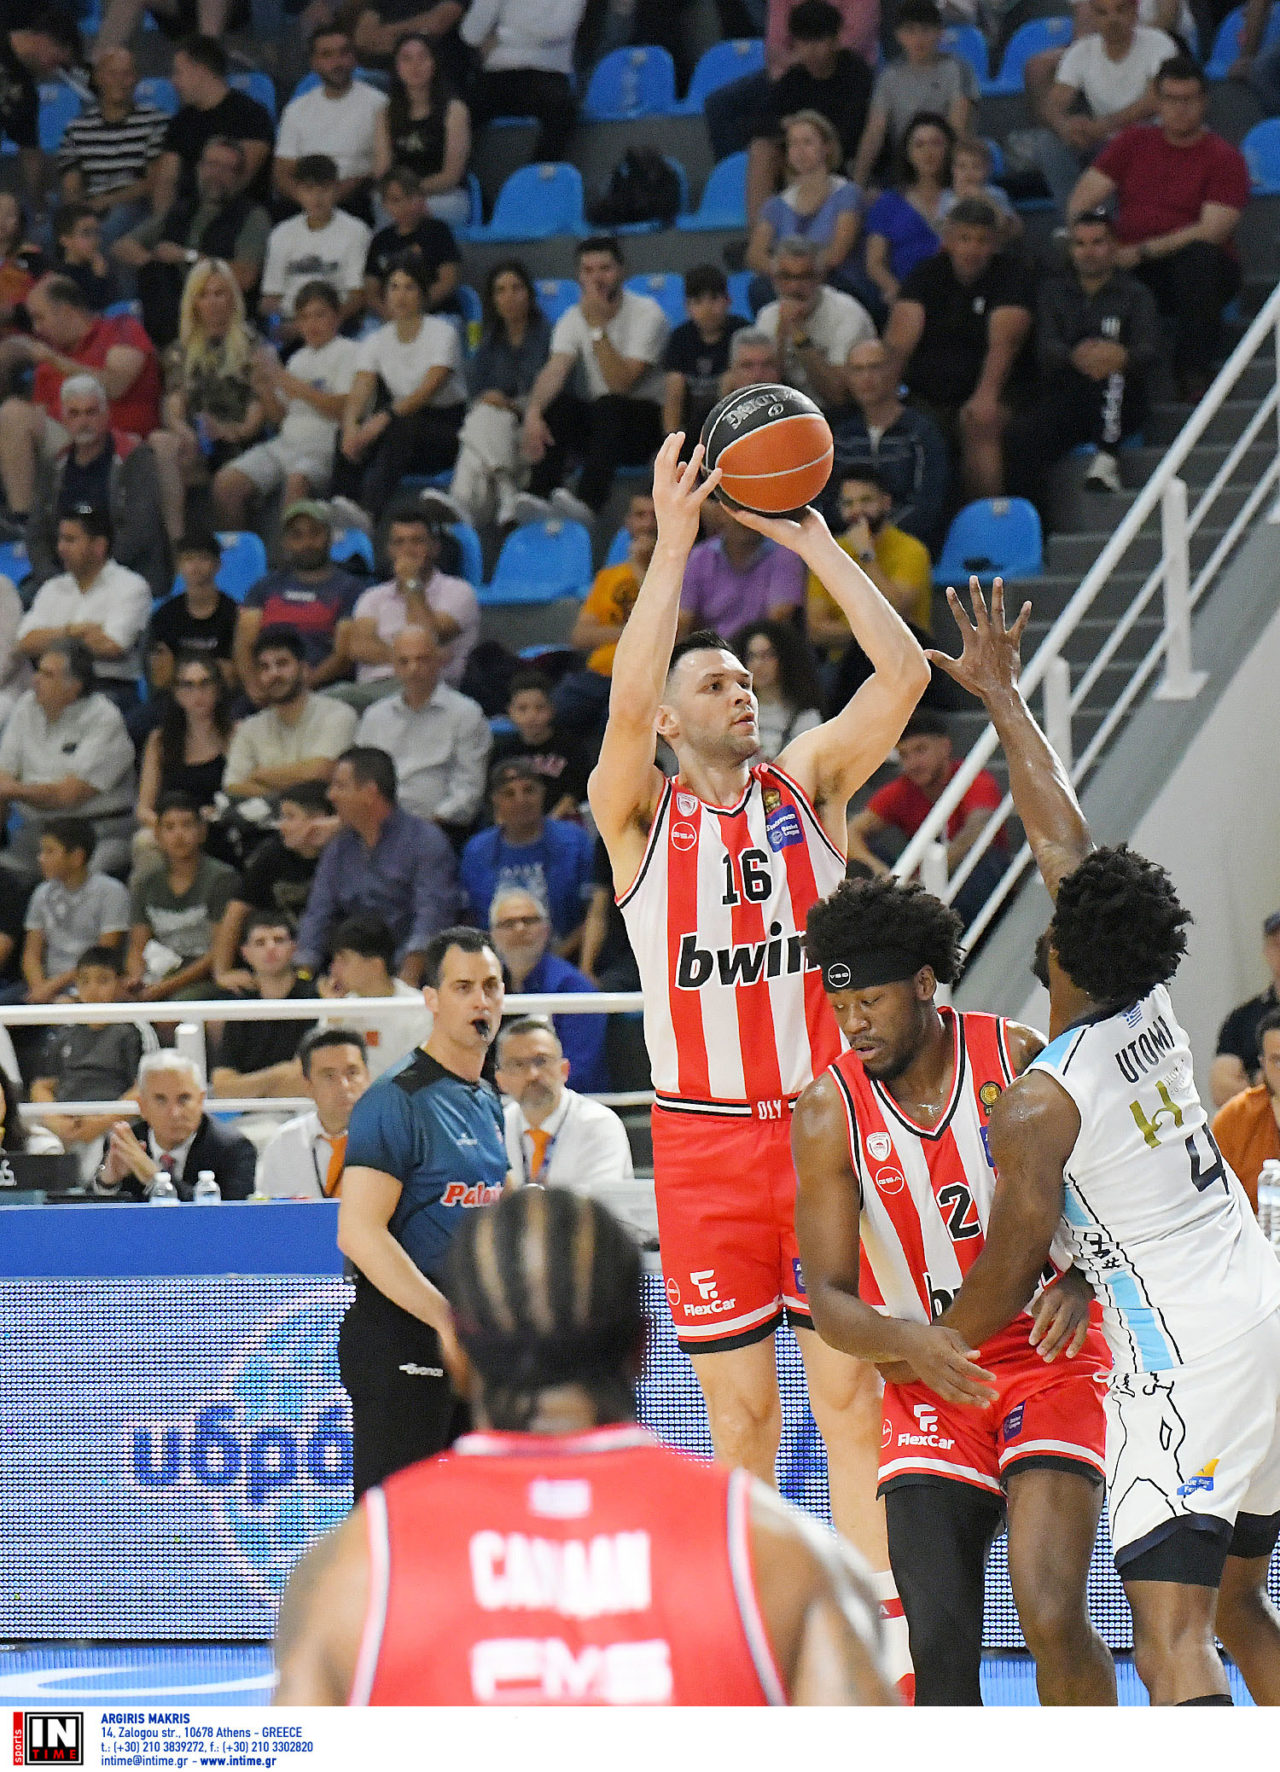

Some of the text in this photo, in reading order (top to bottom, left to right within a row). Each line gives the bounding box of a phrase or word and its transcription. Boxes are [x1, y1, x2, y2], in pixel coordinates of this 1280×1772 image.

[722, 849, 772, 906] 16
[1114, 1015, 1176, 1084] UTOMI
[757, 1100, 782, 1120] OLY
[1185, 1122, 1230, 1193] 4
[936, 1182, 982, 1240] 2
[683, 1298, 736, 1317] FlexCar
[897, 1432, 955, 1450] FlexCar
